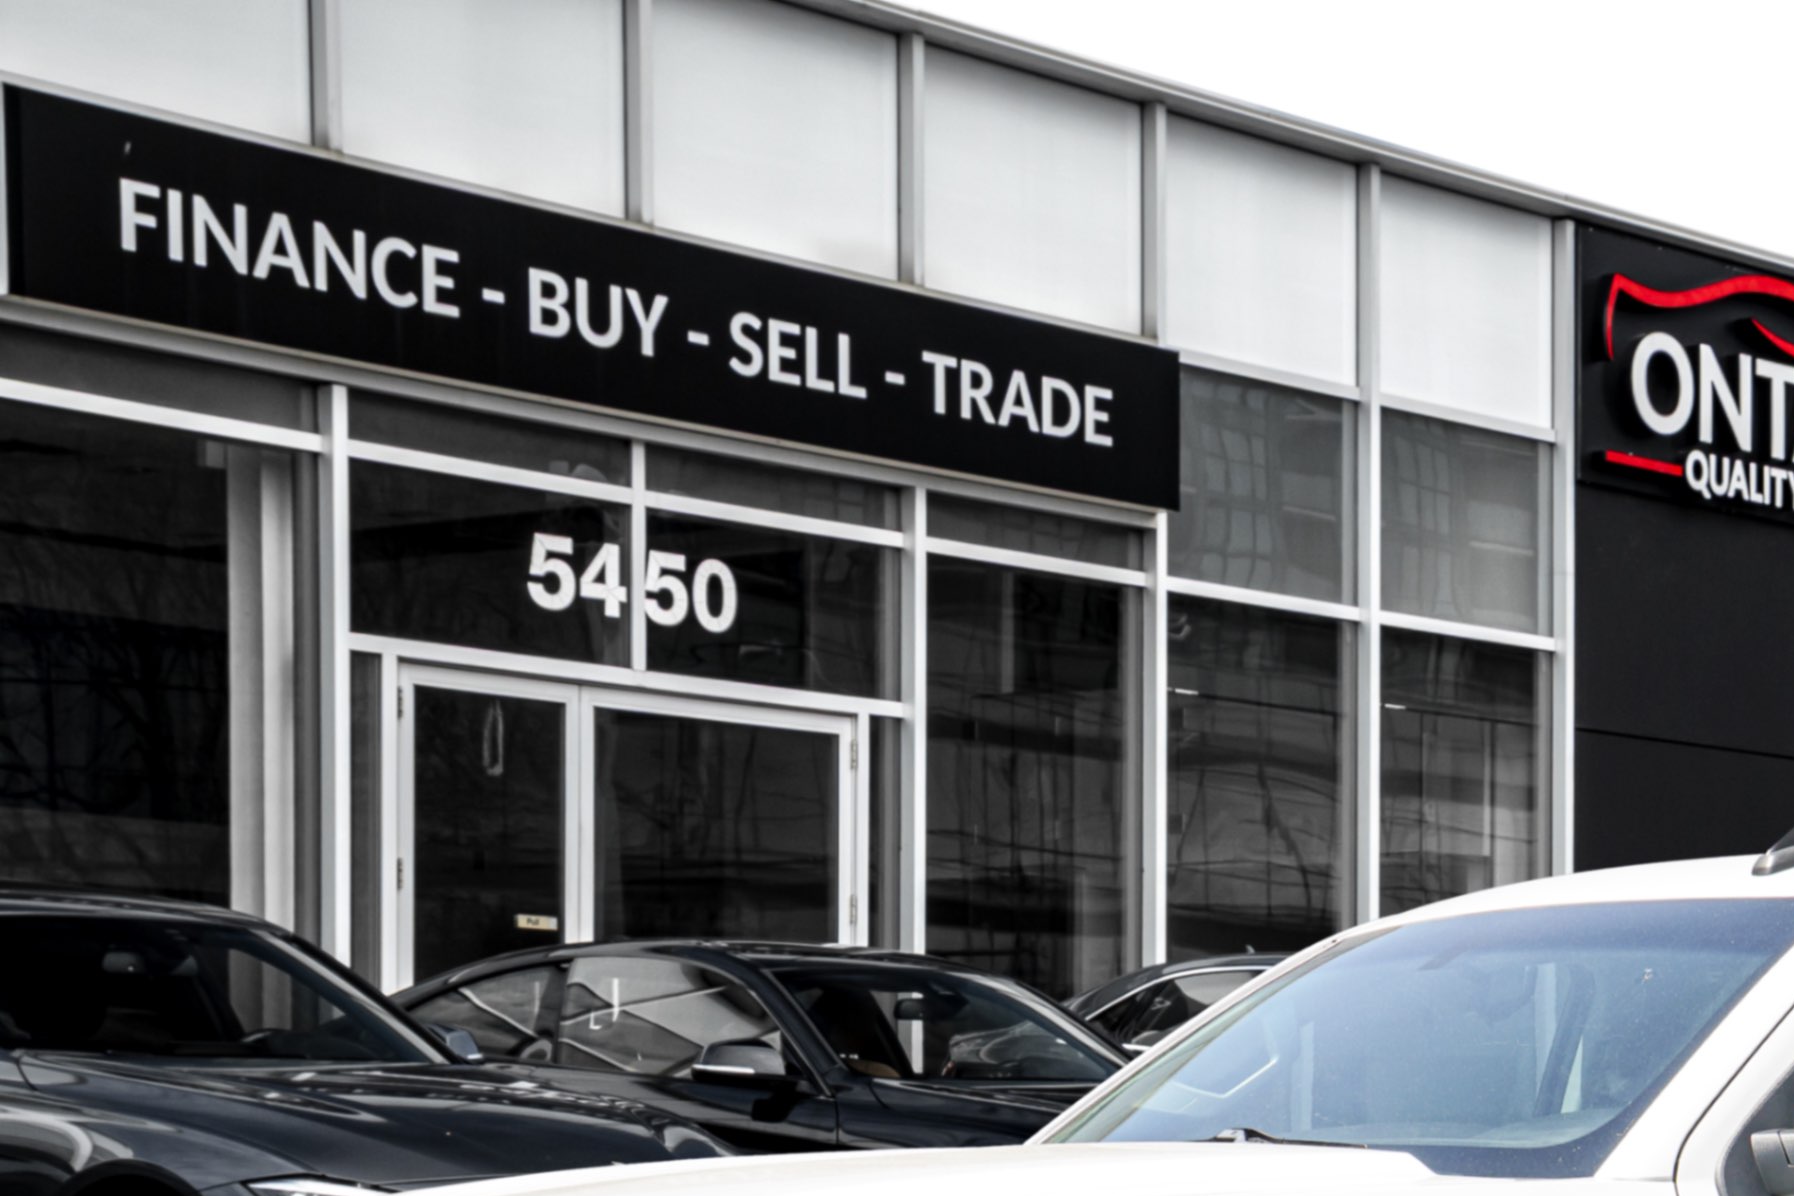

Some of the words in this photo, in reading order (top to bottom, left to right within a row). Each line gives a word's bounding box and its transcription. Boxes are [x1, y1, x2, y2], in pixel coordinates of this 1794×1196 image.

[119, 177, 460, 318] FINANCE
[528, 267, 669, 357] BUY
[729, 311, 867, 399] SELL
[922, 350, 1113, 447] TRADE
[526, 532, 738, 634] 5450
